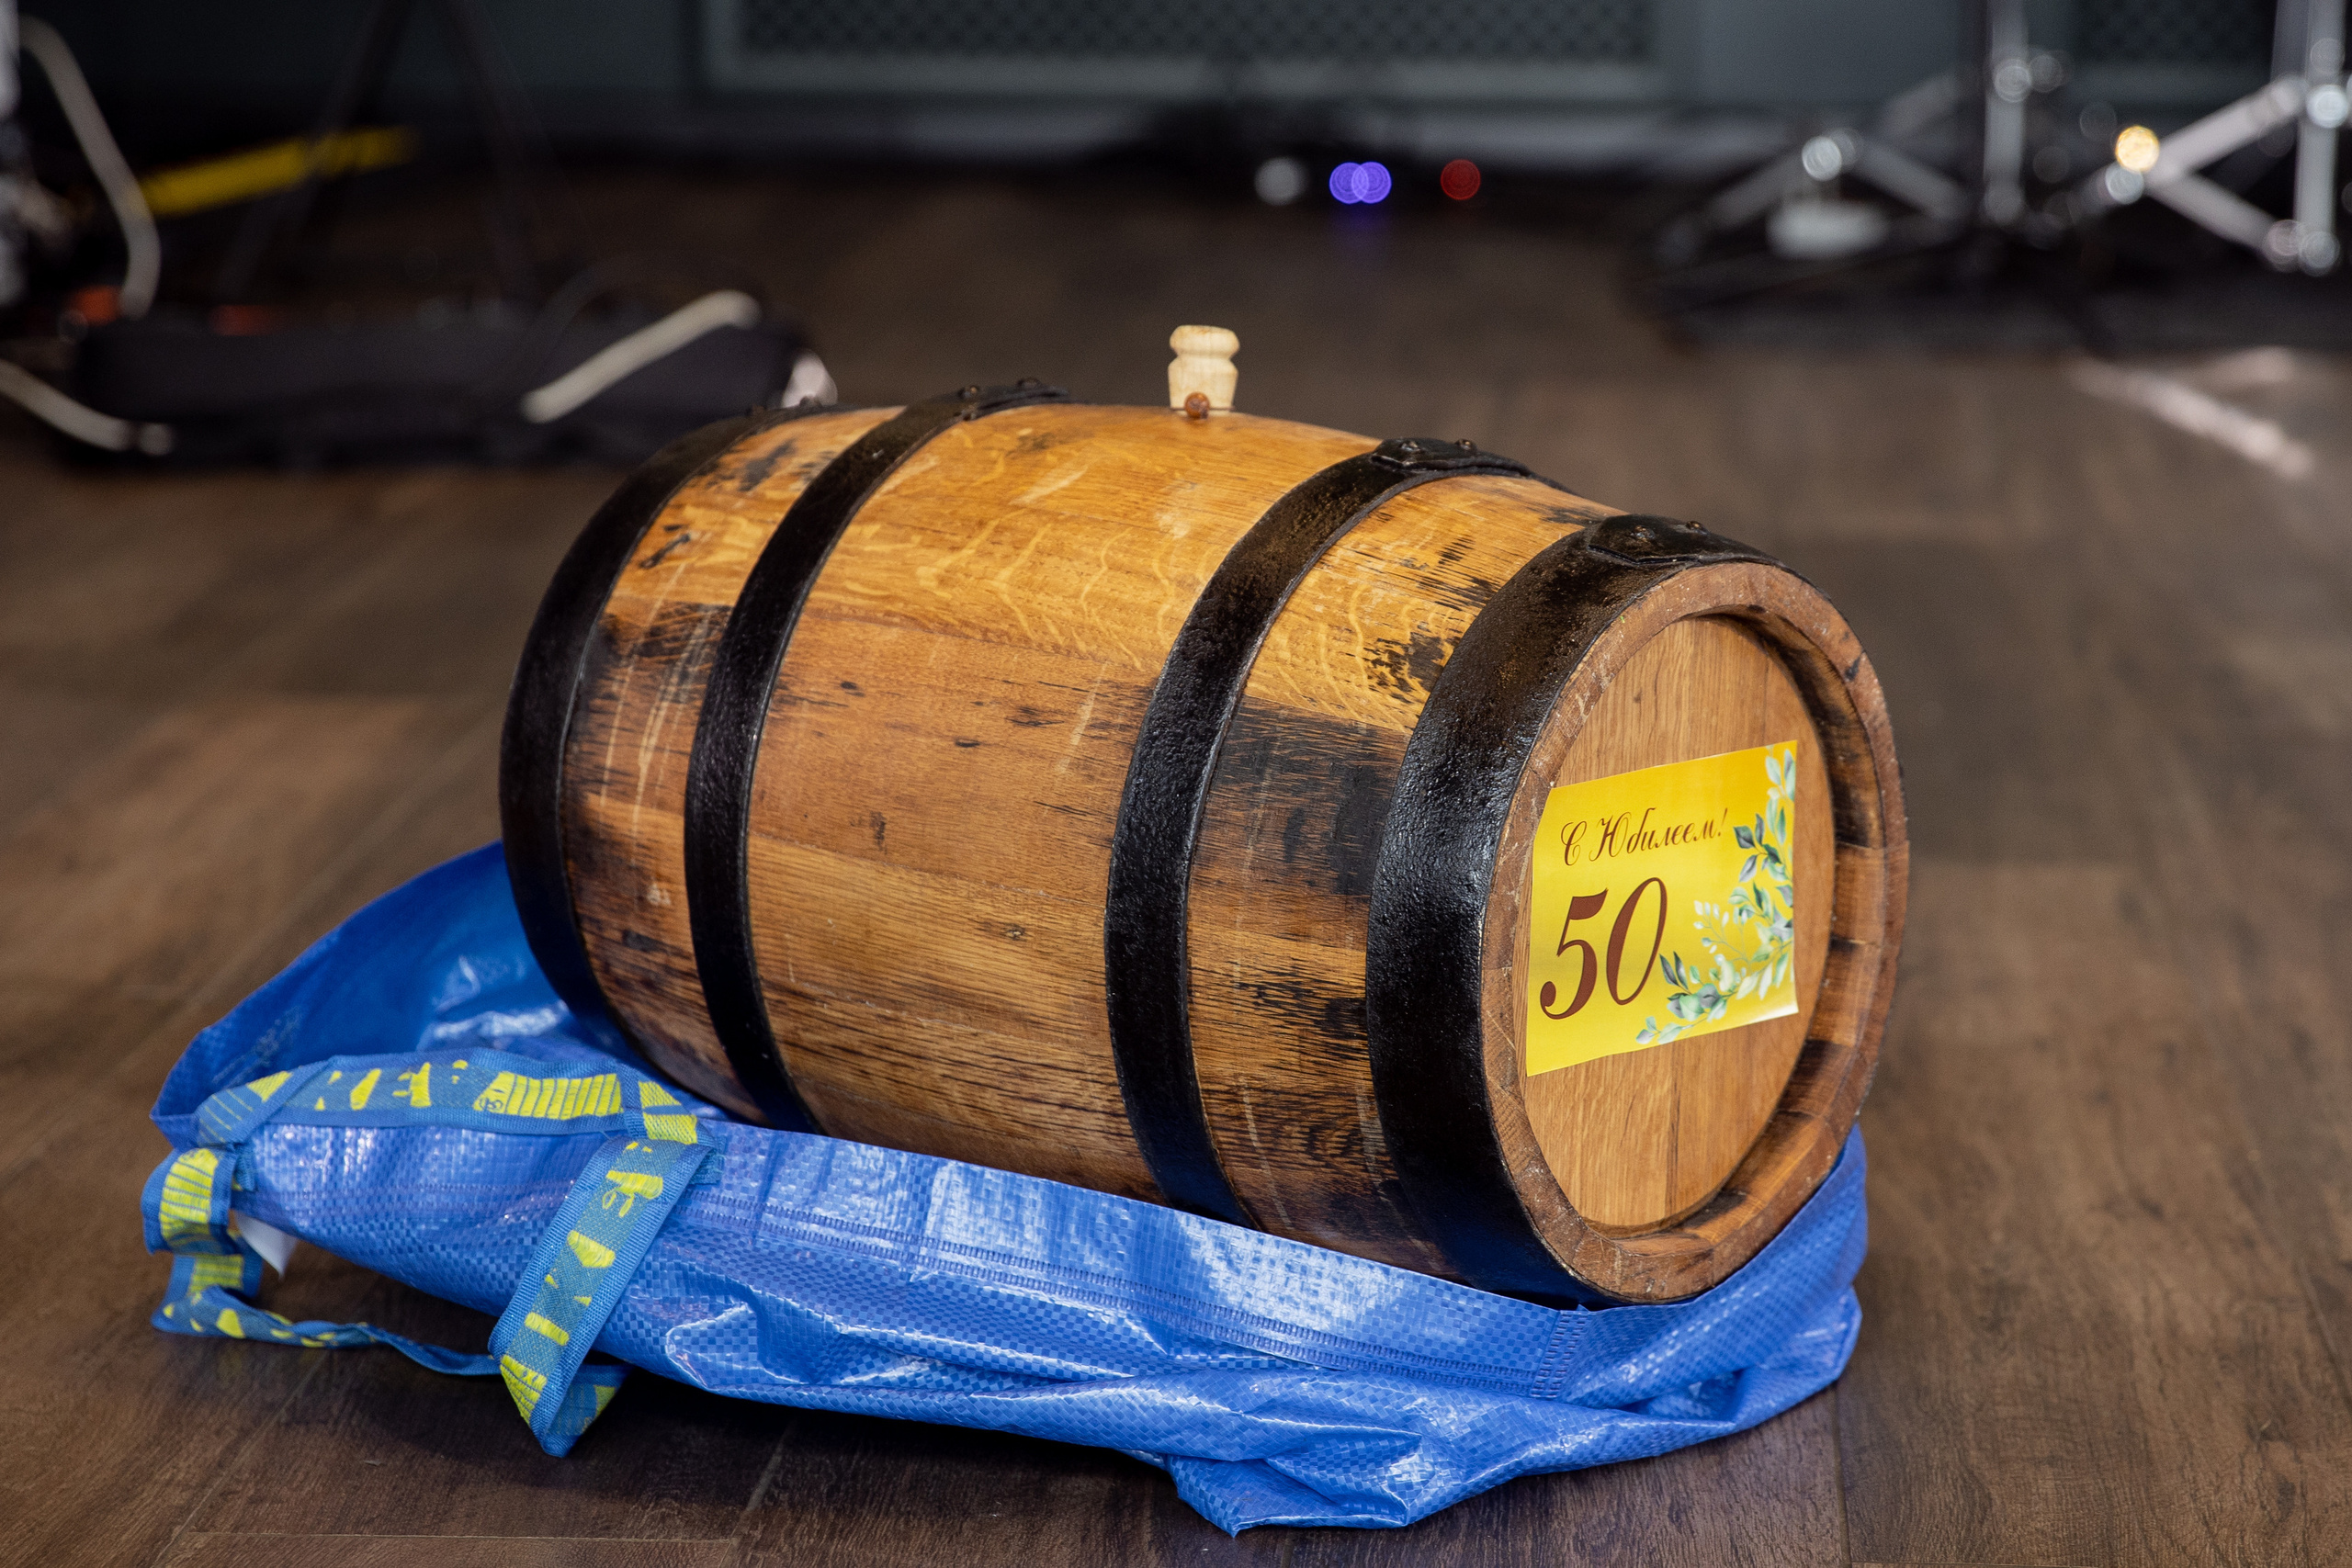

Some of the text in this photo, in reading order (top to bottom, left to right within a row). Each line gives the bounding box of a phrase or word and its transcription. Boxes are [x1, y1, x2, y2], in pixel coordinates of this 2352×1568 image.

[1560, 807, 1728, 866] С Юбилеем!
[1540, 876, 1668, 1020] 50
